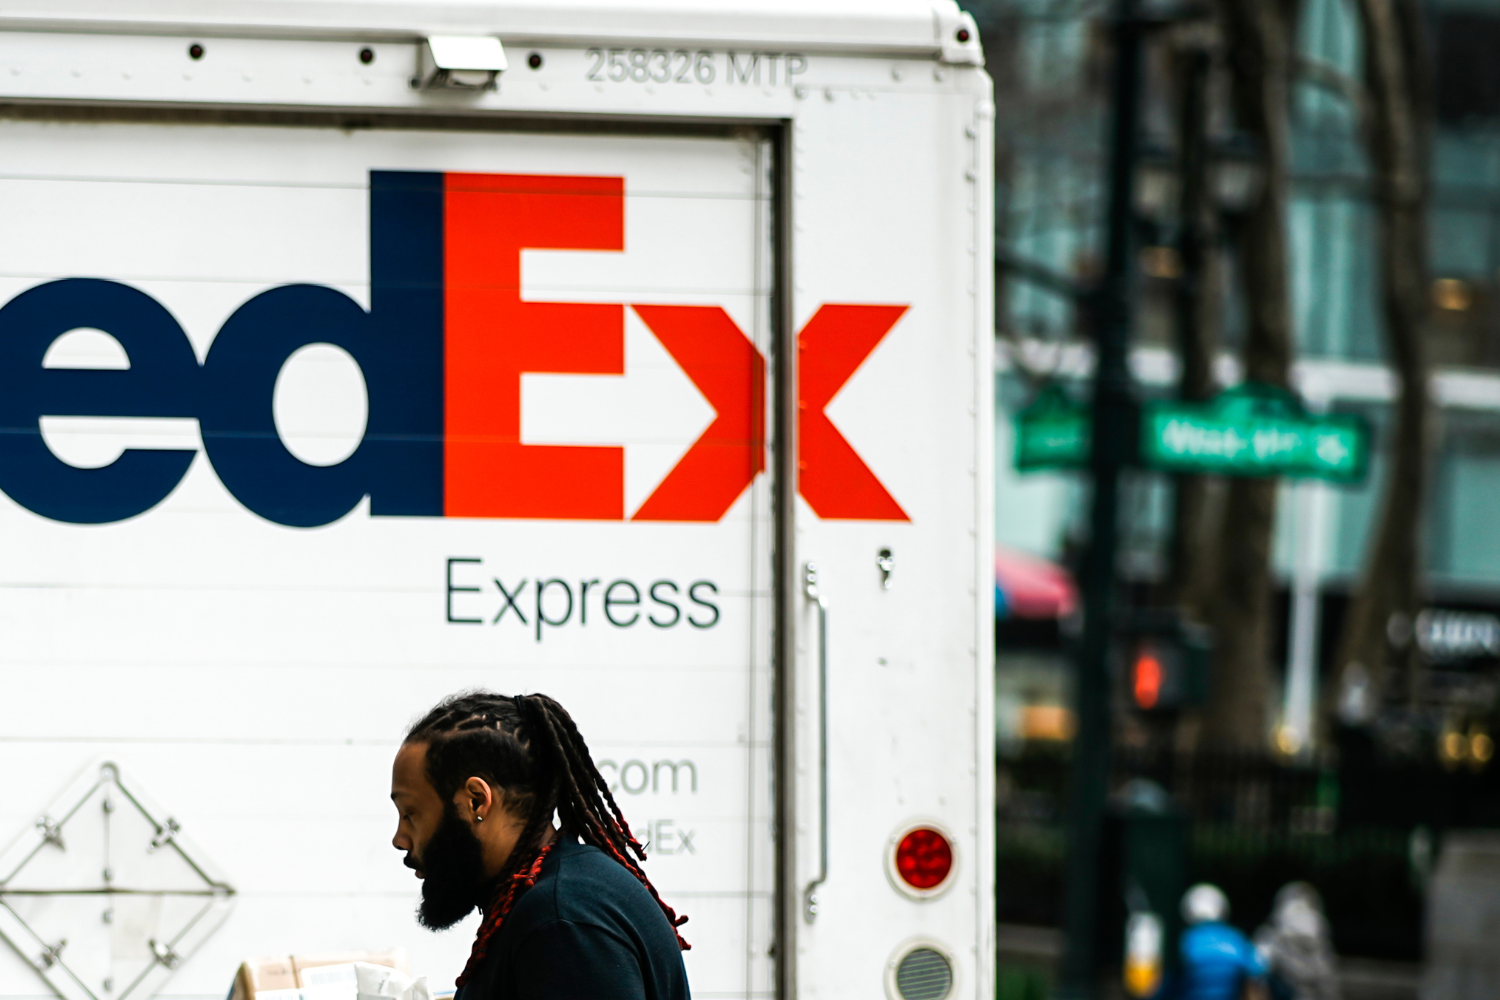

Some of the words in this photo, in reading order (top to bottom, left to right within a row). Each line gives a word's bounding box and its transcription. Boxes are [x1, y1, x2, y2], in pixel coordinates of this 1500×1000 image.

[585, 48, 716, 84] 258326
[726, 50, 808, 87] MTP
[445, 557, 721, 641] Express
